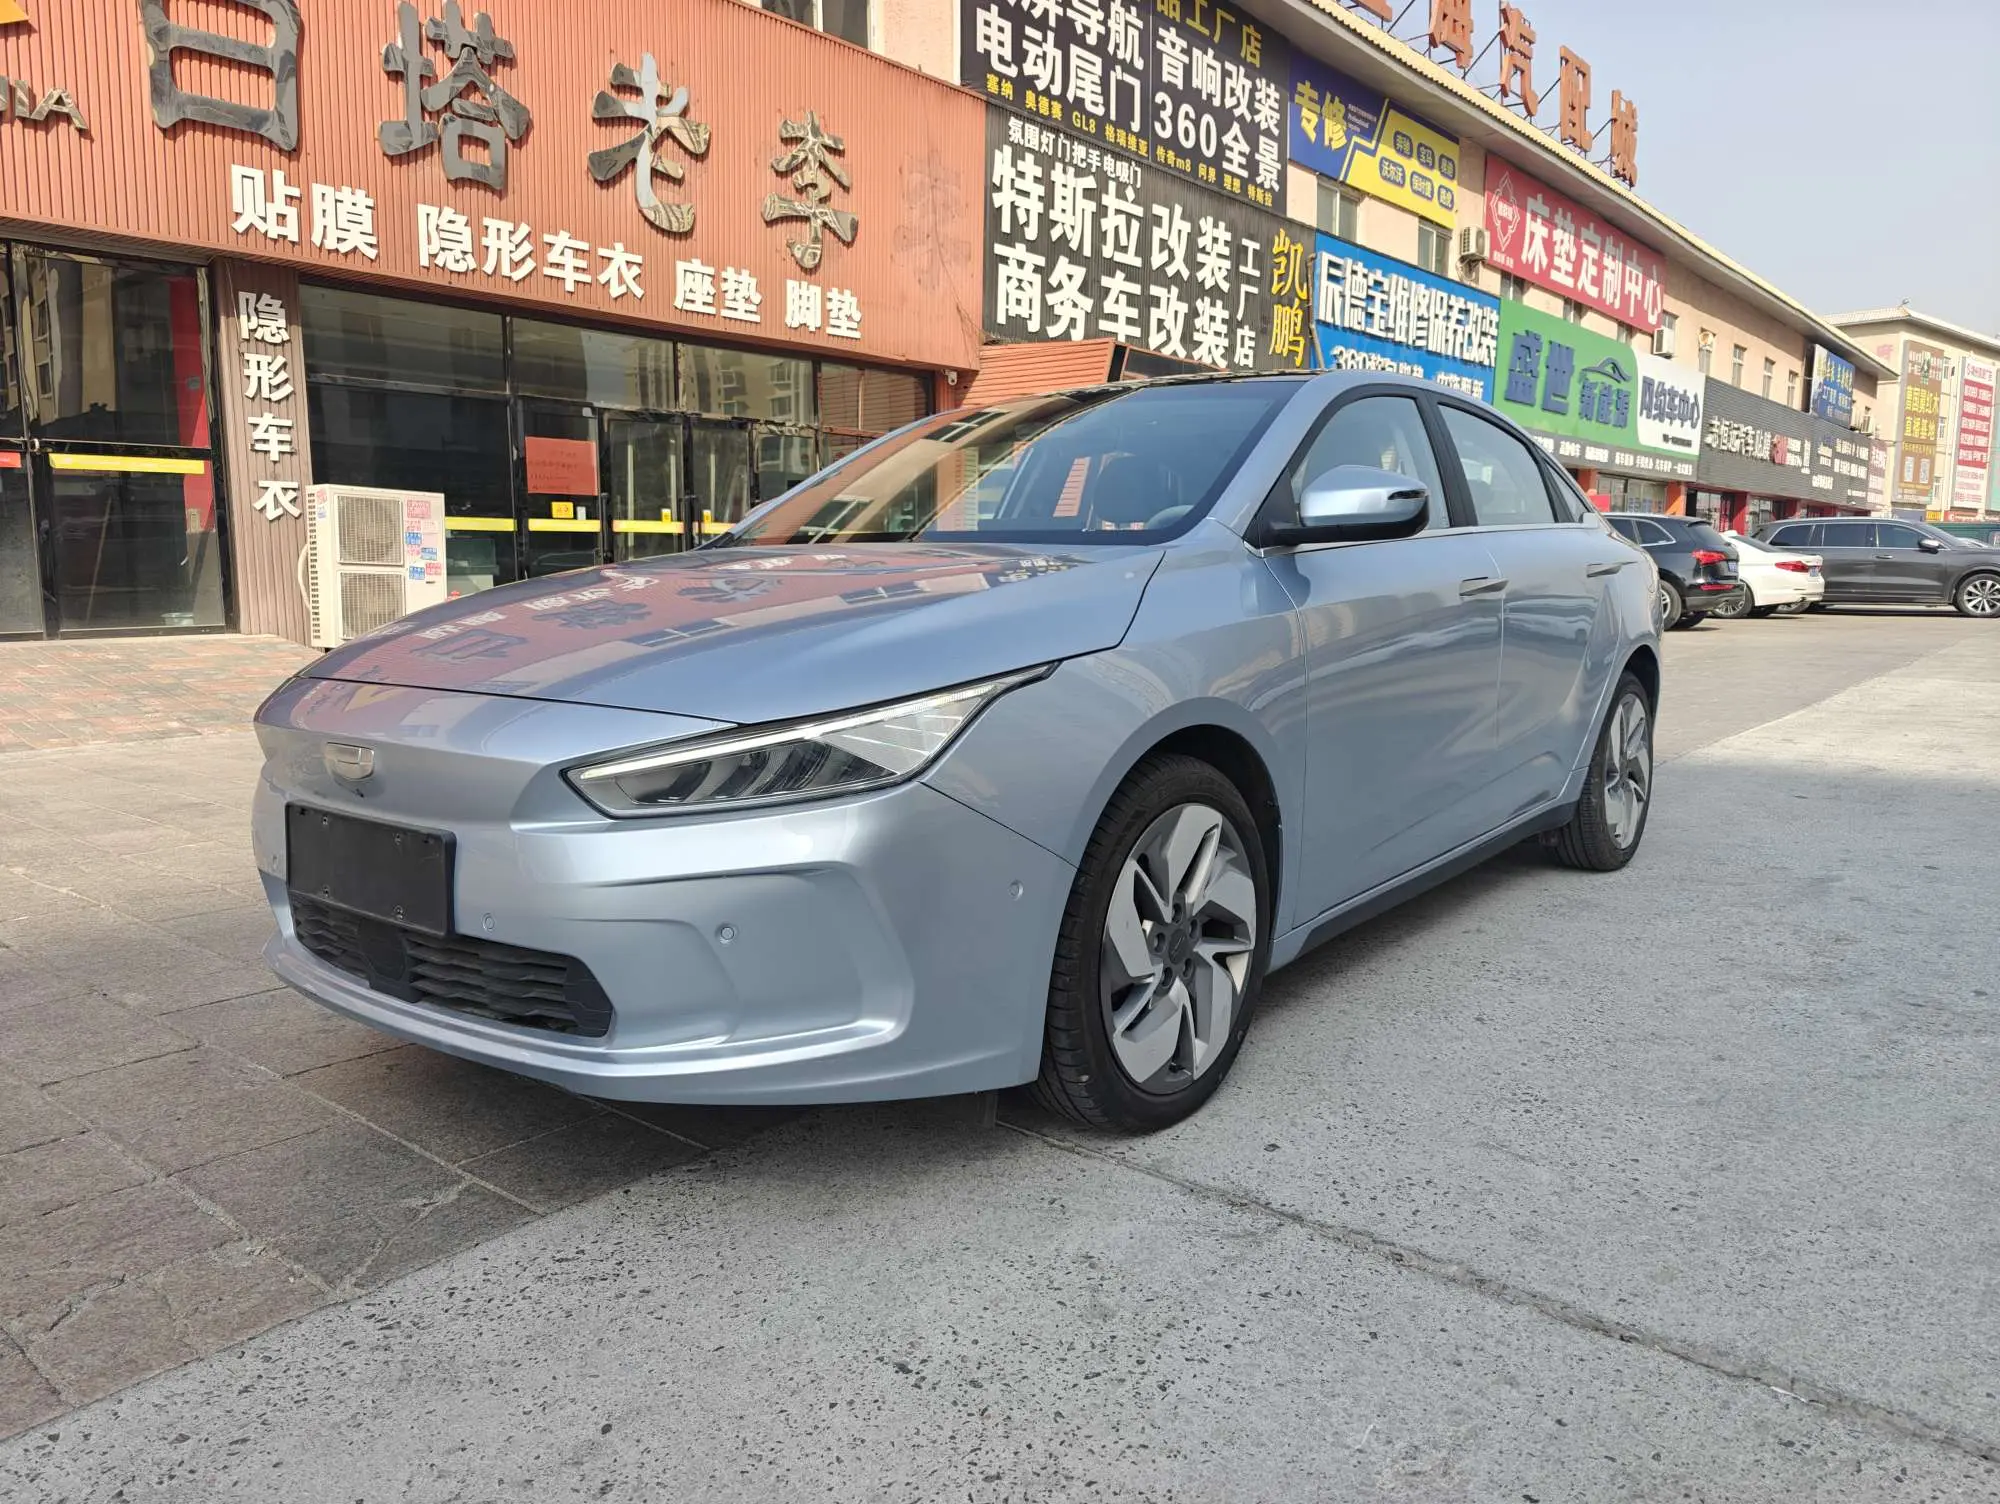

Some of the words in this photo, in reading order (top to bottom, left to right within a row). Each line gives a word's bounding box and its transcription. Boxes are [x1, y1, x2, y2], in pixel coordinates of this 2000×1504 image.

[976, 3, 1142, 133] 电动尾门
[1025, 89, 1063, 121] 奥德赛
[1072, 111, 1096, 134] GL8
[1105, 123, 1148, 157] 格瑞维亚
[1156, 26, 1281, 137] 音响改装
[1294, 80, 1348, 151] 专修
[1154, 91, 1282, 193] 360全景
[231, 164, 379, 260] 贴膜
[417, 203, 645, 300] 隐形车衣
[673, 258, 762, 323] 座垫
[785, 279, 862, 339] 脚垫
[992, 145, 1232, 294] 特斯拉改装
[1521, 193, 1663, 325] 床垫定制中心
[993, 243, 1230, 370] 商务车改装
[1233, 237, 1261, 368] 工厂店
[1269, 227, 1307, 369] 凯鹏
[238, 291, 301, 522] 隐形车衣
